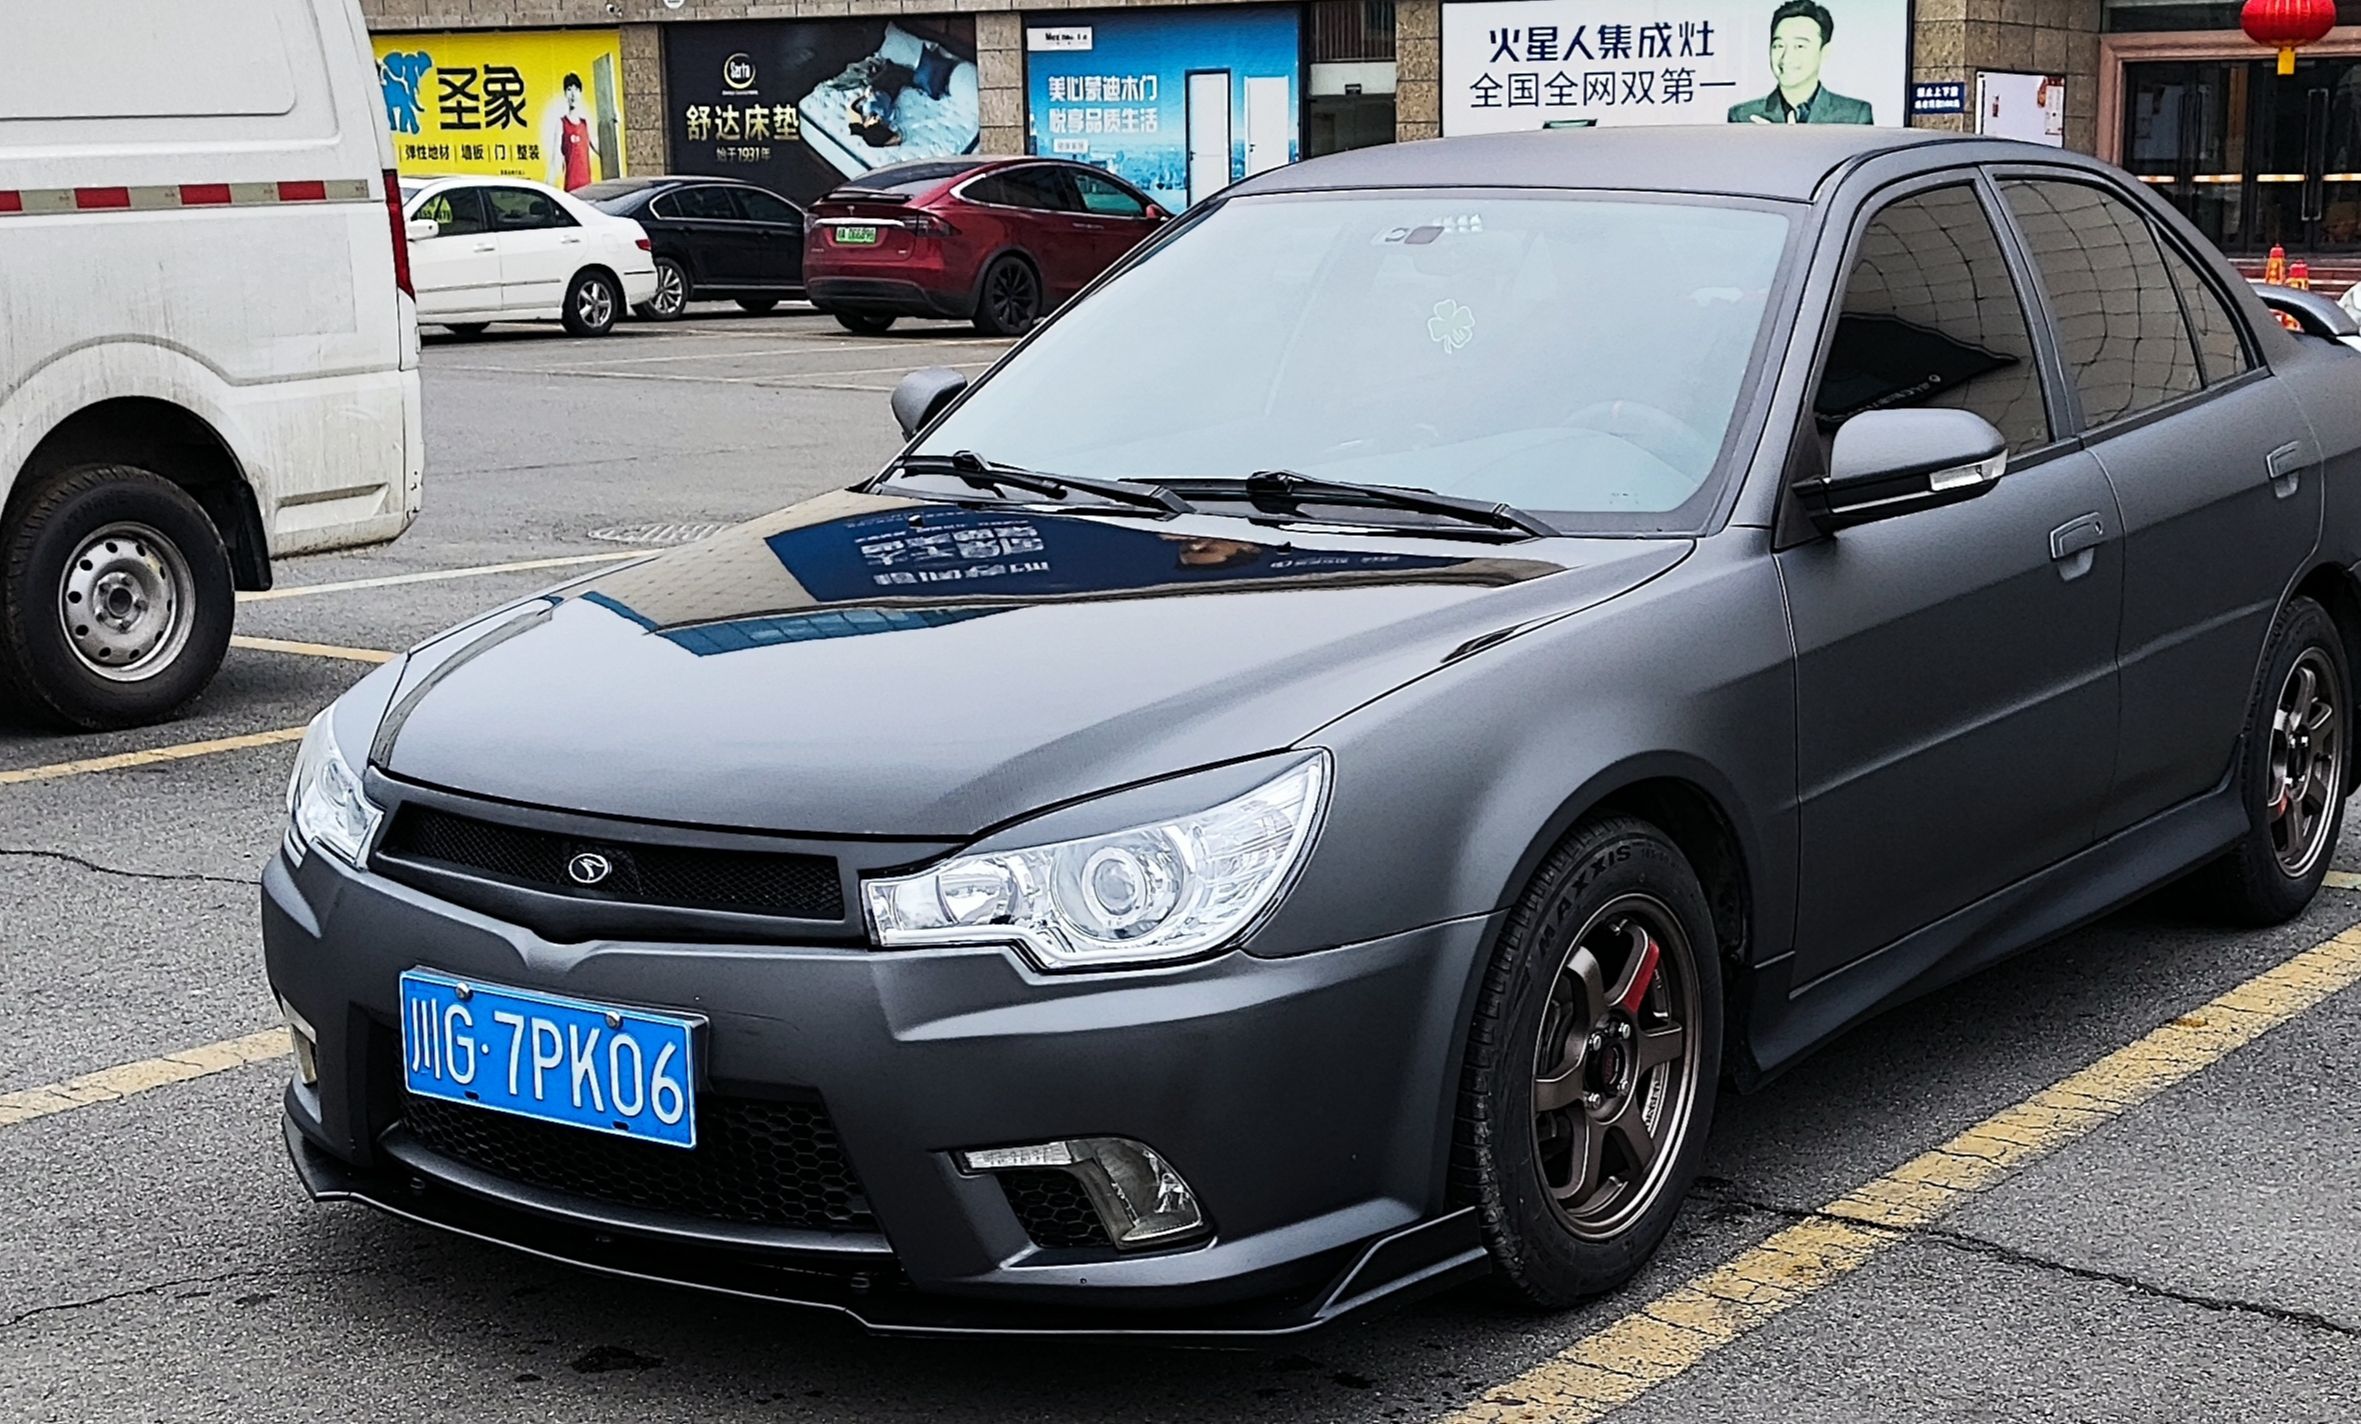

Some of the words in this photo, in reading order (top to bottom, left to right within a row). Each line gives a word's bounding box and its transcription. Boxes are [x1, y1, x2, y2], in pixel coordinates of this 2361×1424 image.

[1489, 20, 1715, 63] 火星人集成灶
[437, 64, 528, 130] 圣象
[1048, 74, 1158, 102] 美心蒙迪木门
[1469, 67, 1737, 109] 全国全网双第一
[686, 103, 800, 141] 舒达床垫
[405, 144, 450, 161] 弹性地材
[494, 144, 506, 161] 门
[516, 144, 540, 161] 整装
[716, 146, 771, 161] 始于1931年
[1538, 844, 1632, 958] MAXXIS
[411, 997, 685, 1125] 川G·7PK06
